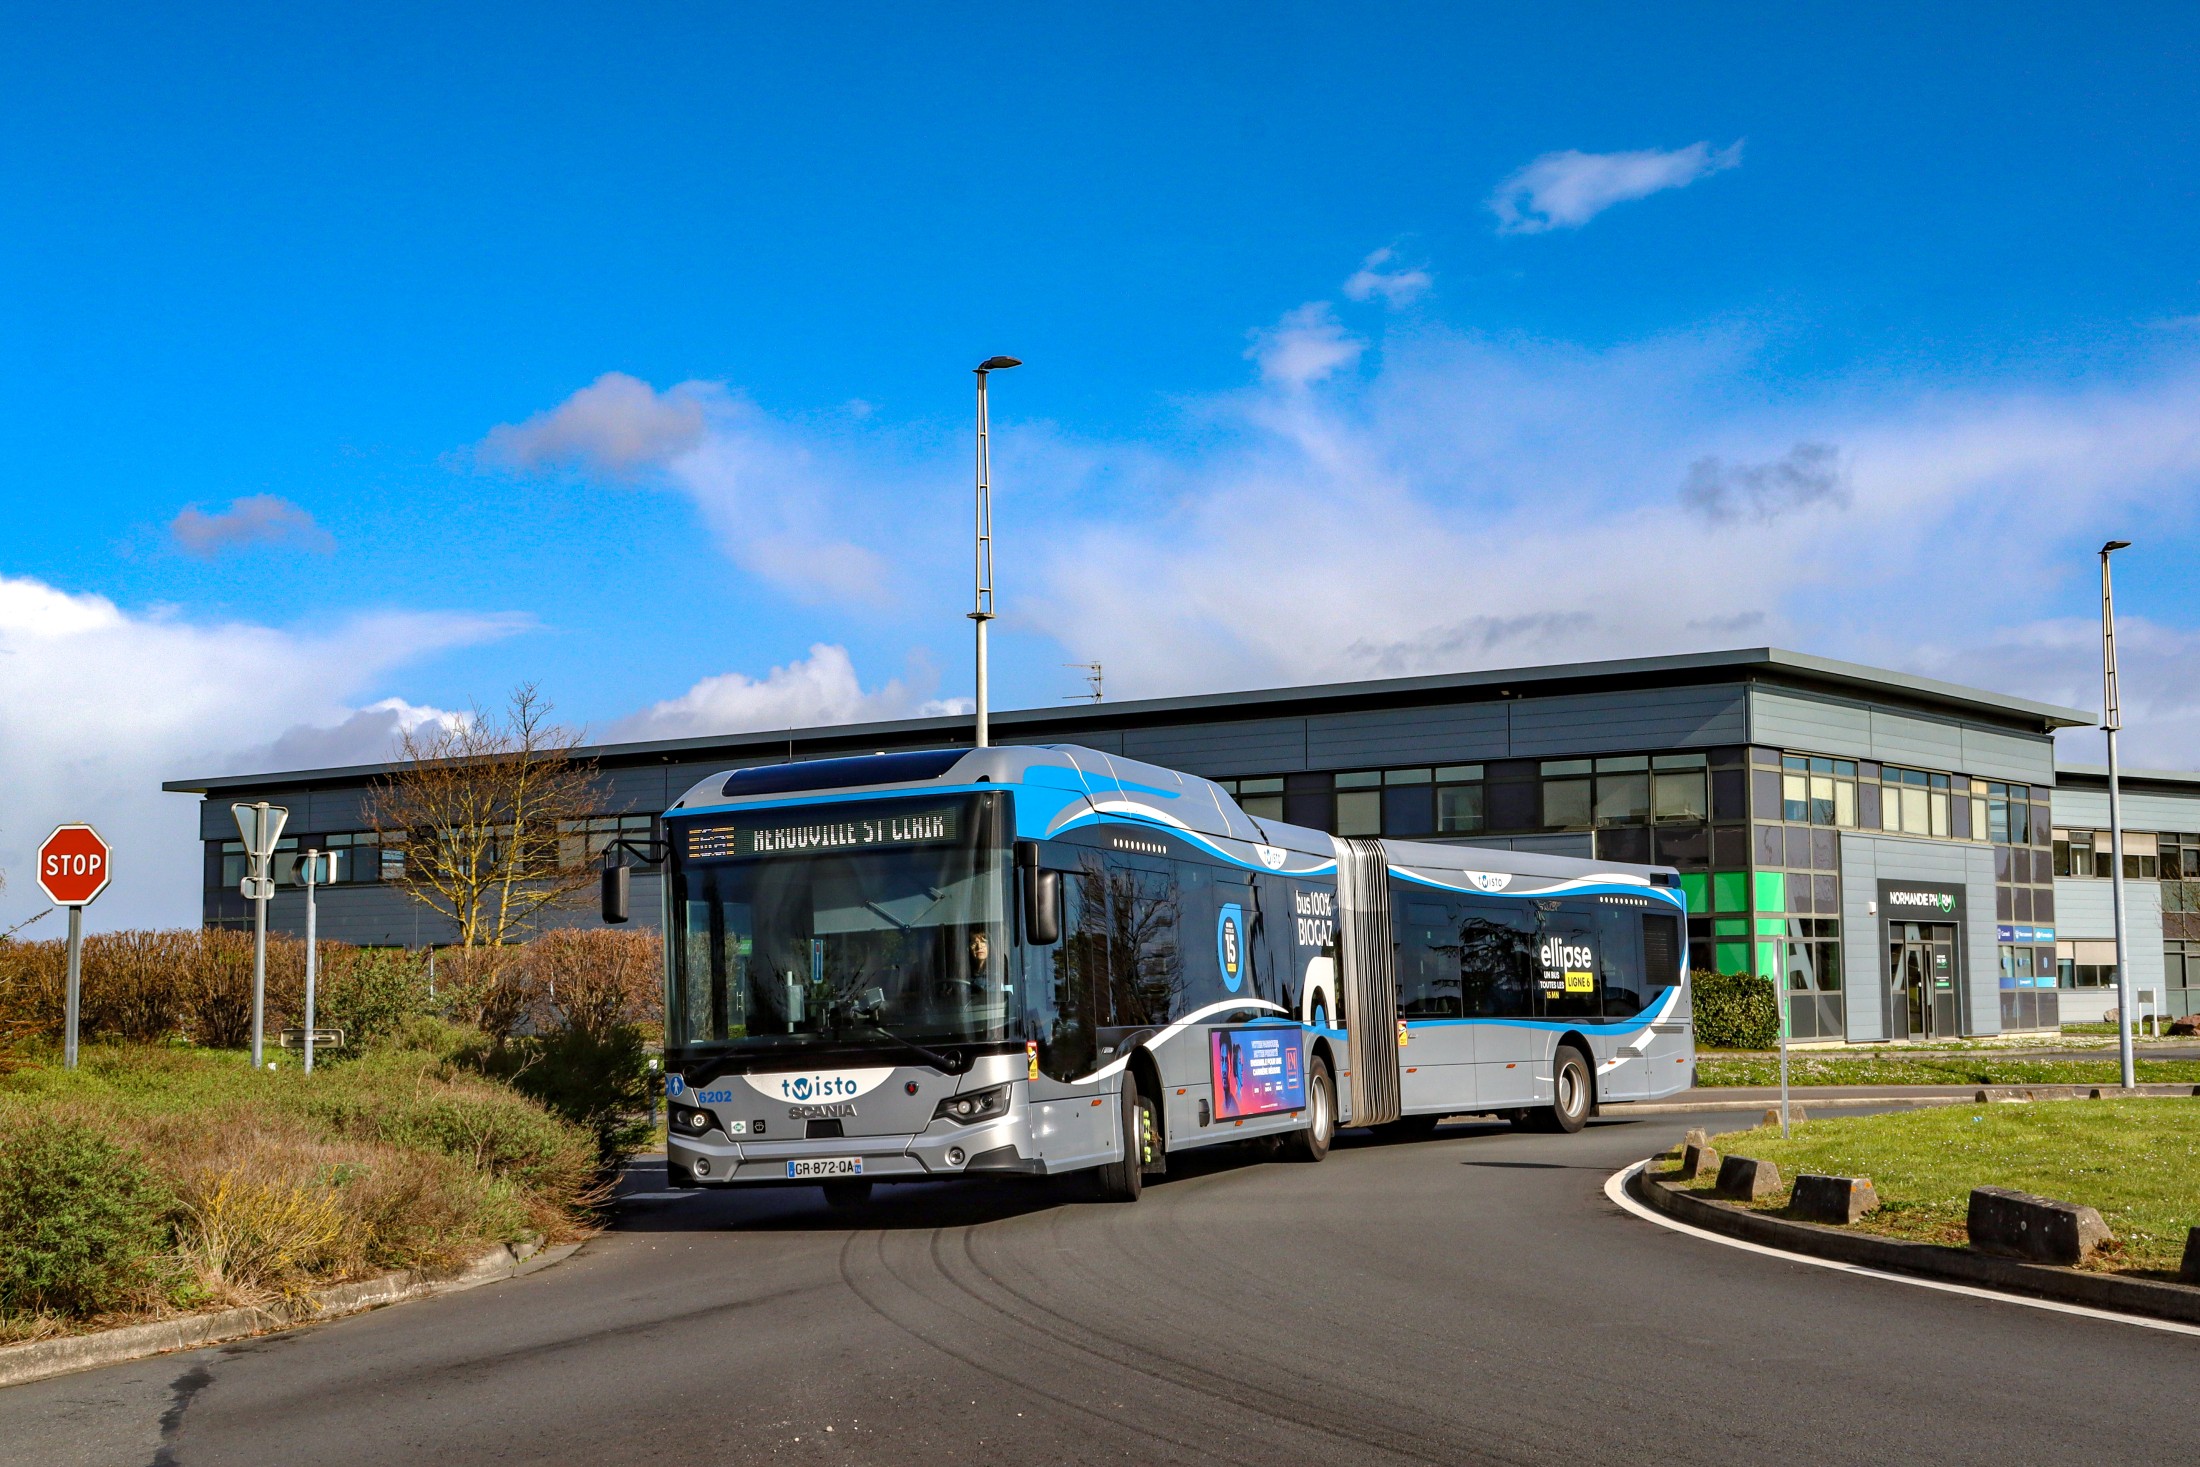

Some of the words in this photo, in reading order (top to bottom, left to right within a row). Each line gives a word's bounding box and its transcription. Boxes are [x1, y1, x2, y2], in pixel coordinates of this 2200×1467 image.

[46, 854, 101, 876] STOP
[1478, 874, 1502, 888] twisto
[1296, 890, 1310, 915] bus
[1310, 892, 1331, 916] 100%
[1890, 892, 1928, 906] NORMANDIE
[1929, 893, 1956, 912] PHARMA
[1298, 918, 1333, 946] BIOGAZ
[1225, 934, 1236, 962] 15
[1541, 937, 1592, 973] ellipse
[1543, 971, 1550, 979] UN
[1551, 971, 1560, 979] BUS
[1567, 977, 1585, 987] LIGNE
[1586, 977, 1590, 987] 6
[1540, 981, 1556, 989] TOUTES
[1546, 991, 1551, 999] 15
[782, 1076, 857, 1100] twisto
[699, 1090, 732, 1103] 6202
[788, 1104, 857, 1120] SCANIA
[795, 1160, 854, 1175] GR-872-QA
